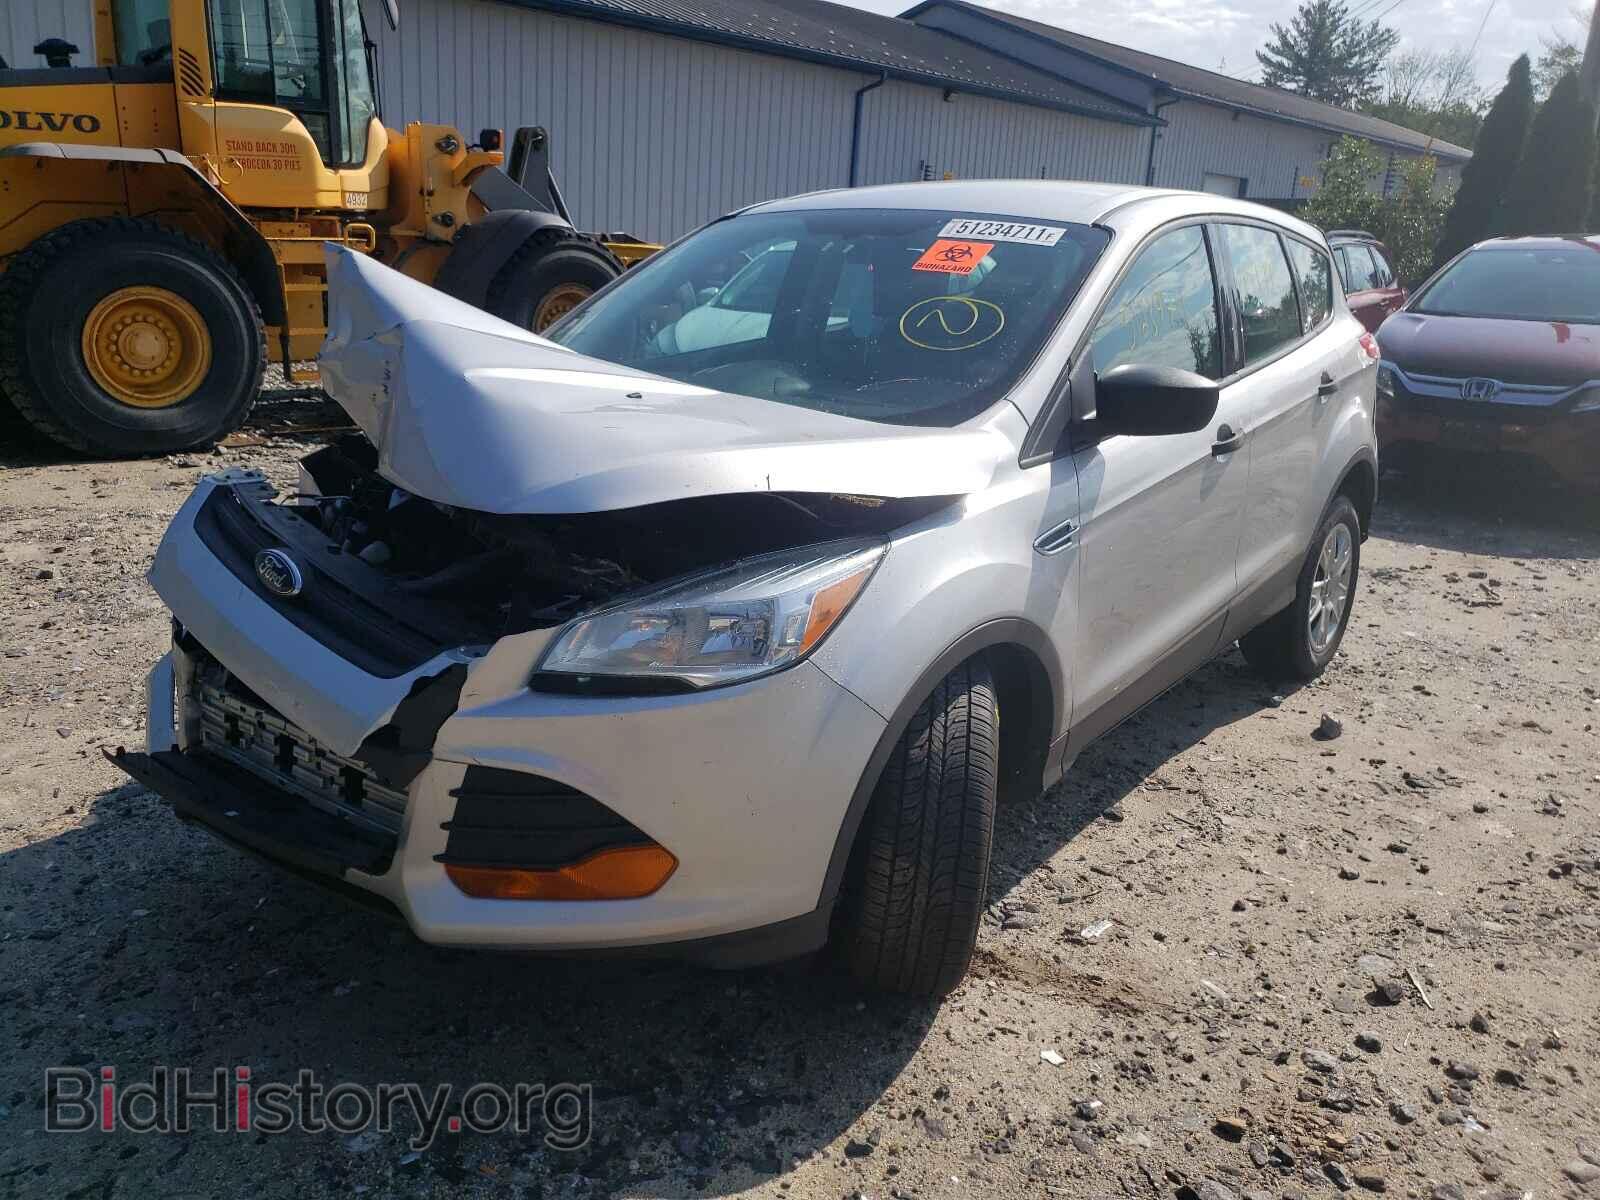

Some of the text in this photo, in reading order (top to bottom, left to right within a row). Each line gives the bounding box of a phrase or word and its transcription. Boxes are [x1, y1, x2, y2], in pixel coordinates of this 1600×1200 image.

[225, 139, 253, 152] STAND
[255, 141, 278, 153] BACK
[273, 159, 282, 170] 30
[284, 159, 302, 170] PIES
[956, 221, 1046, 240] 51234711
[915, 262, 973, 274] BIOHAZARD
[259, 555, 288, 588] Ford
